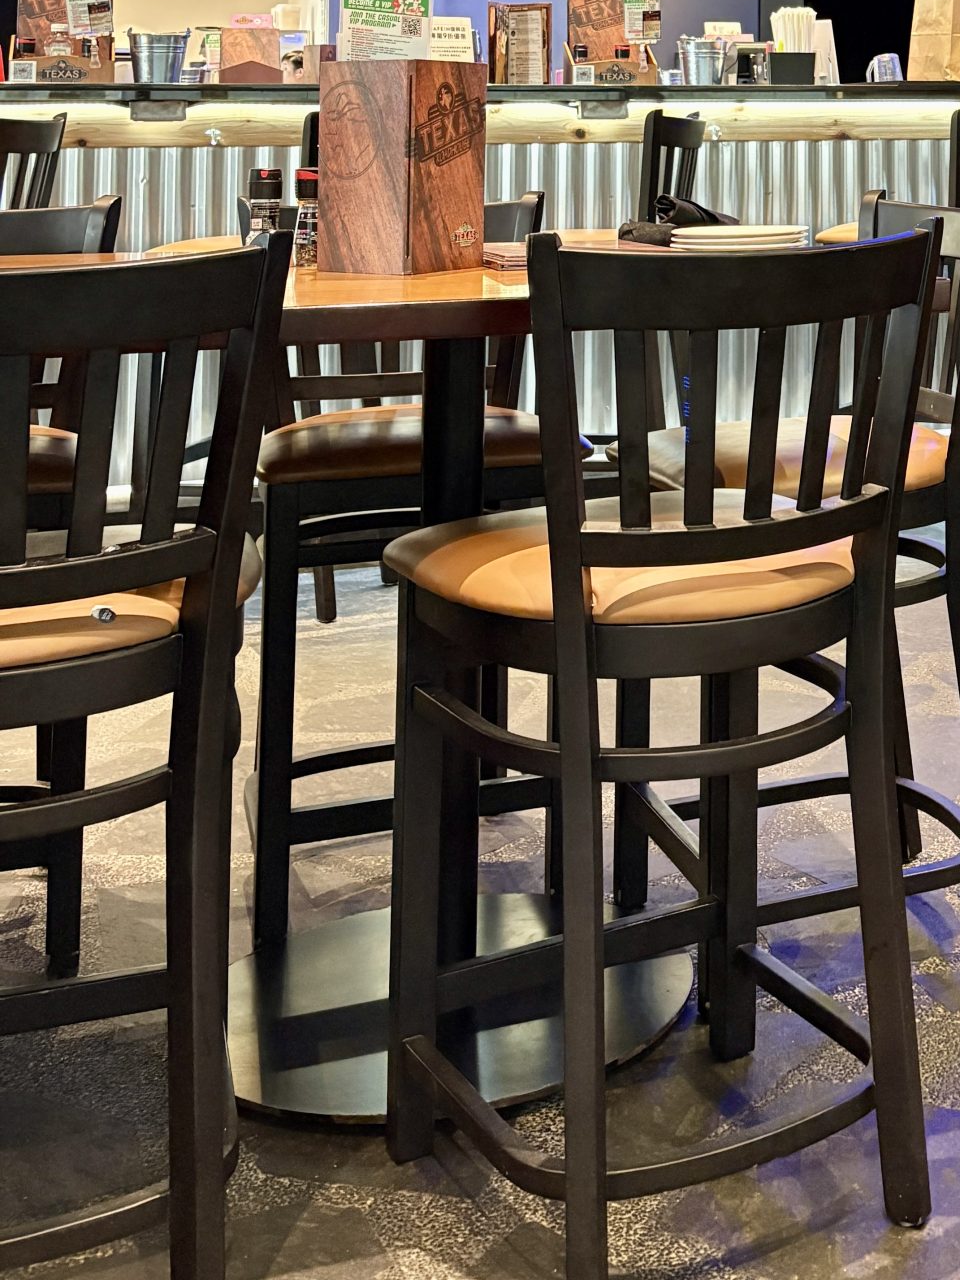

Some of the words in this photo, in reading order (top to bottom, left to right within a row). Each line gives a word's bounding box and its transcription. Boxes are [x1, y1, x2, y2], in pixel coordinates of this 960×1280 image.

[365, 12, 377, 20] THE
[378, 13, 401, 22] CASUAL
[360, 19, 392, 28] PROGRAM
[44, 70, 80, 79] TEXAS
[601, 72, 631, 81] TEXAS
[420, 104, 482, 156] TEXAS
